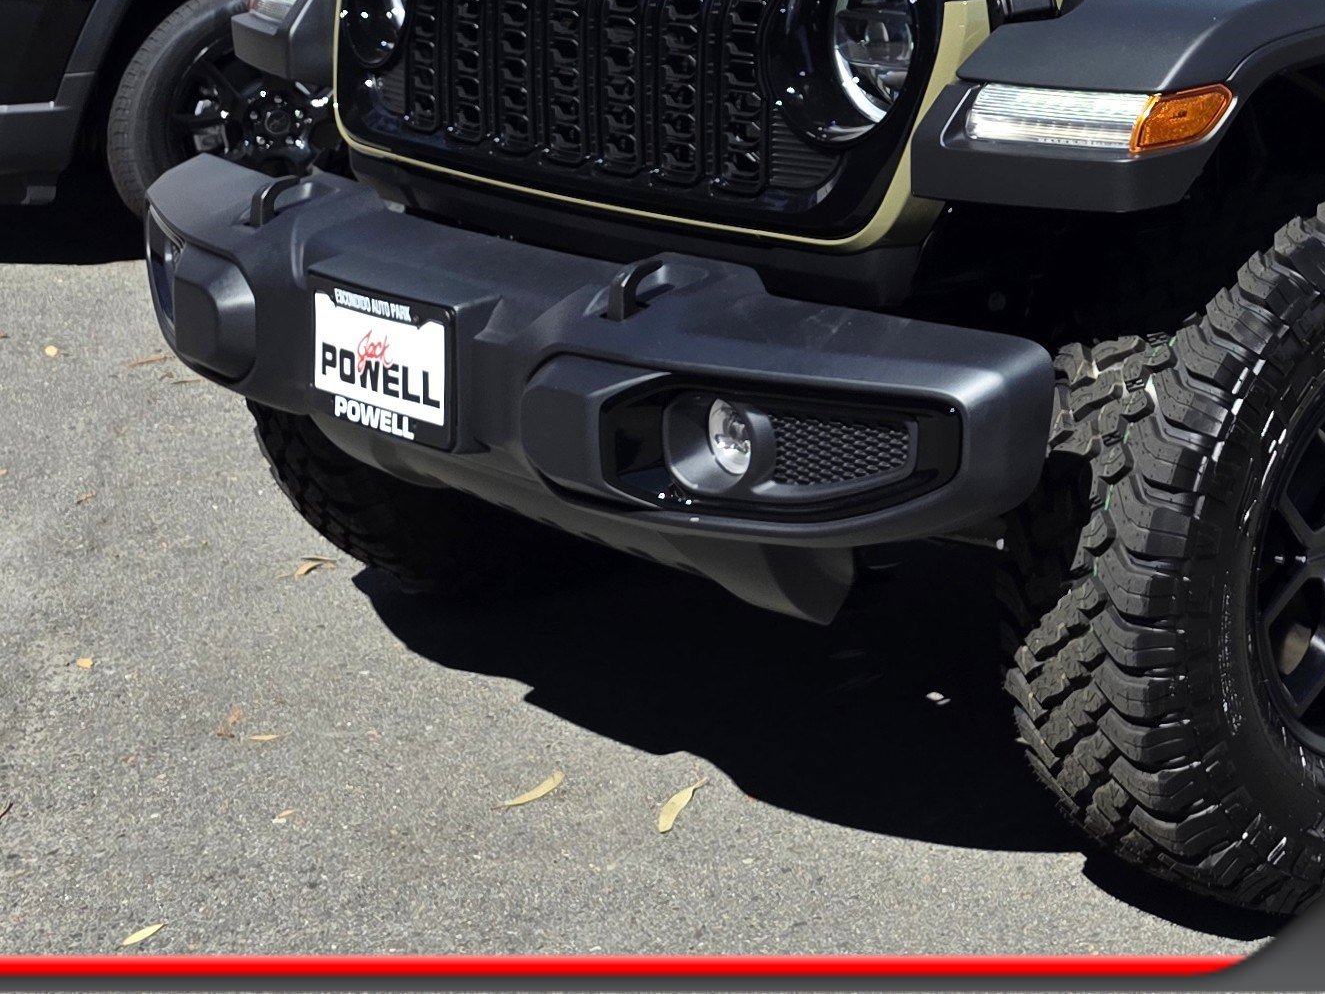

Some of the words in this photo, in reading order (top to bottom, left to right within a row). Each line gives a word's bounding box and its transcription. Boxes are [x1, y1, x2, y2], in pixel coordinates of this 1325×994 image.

[357, 329, 393, 373] Jack
[322, 341, 440, 409] POWELL
[334, 395, 415, 440] POWELL
